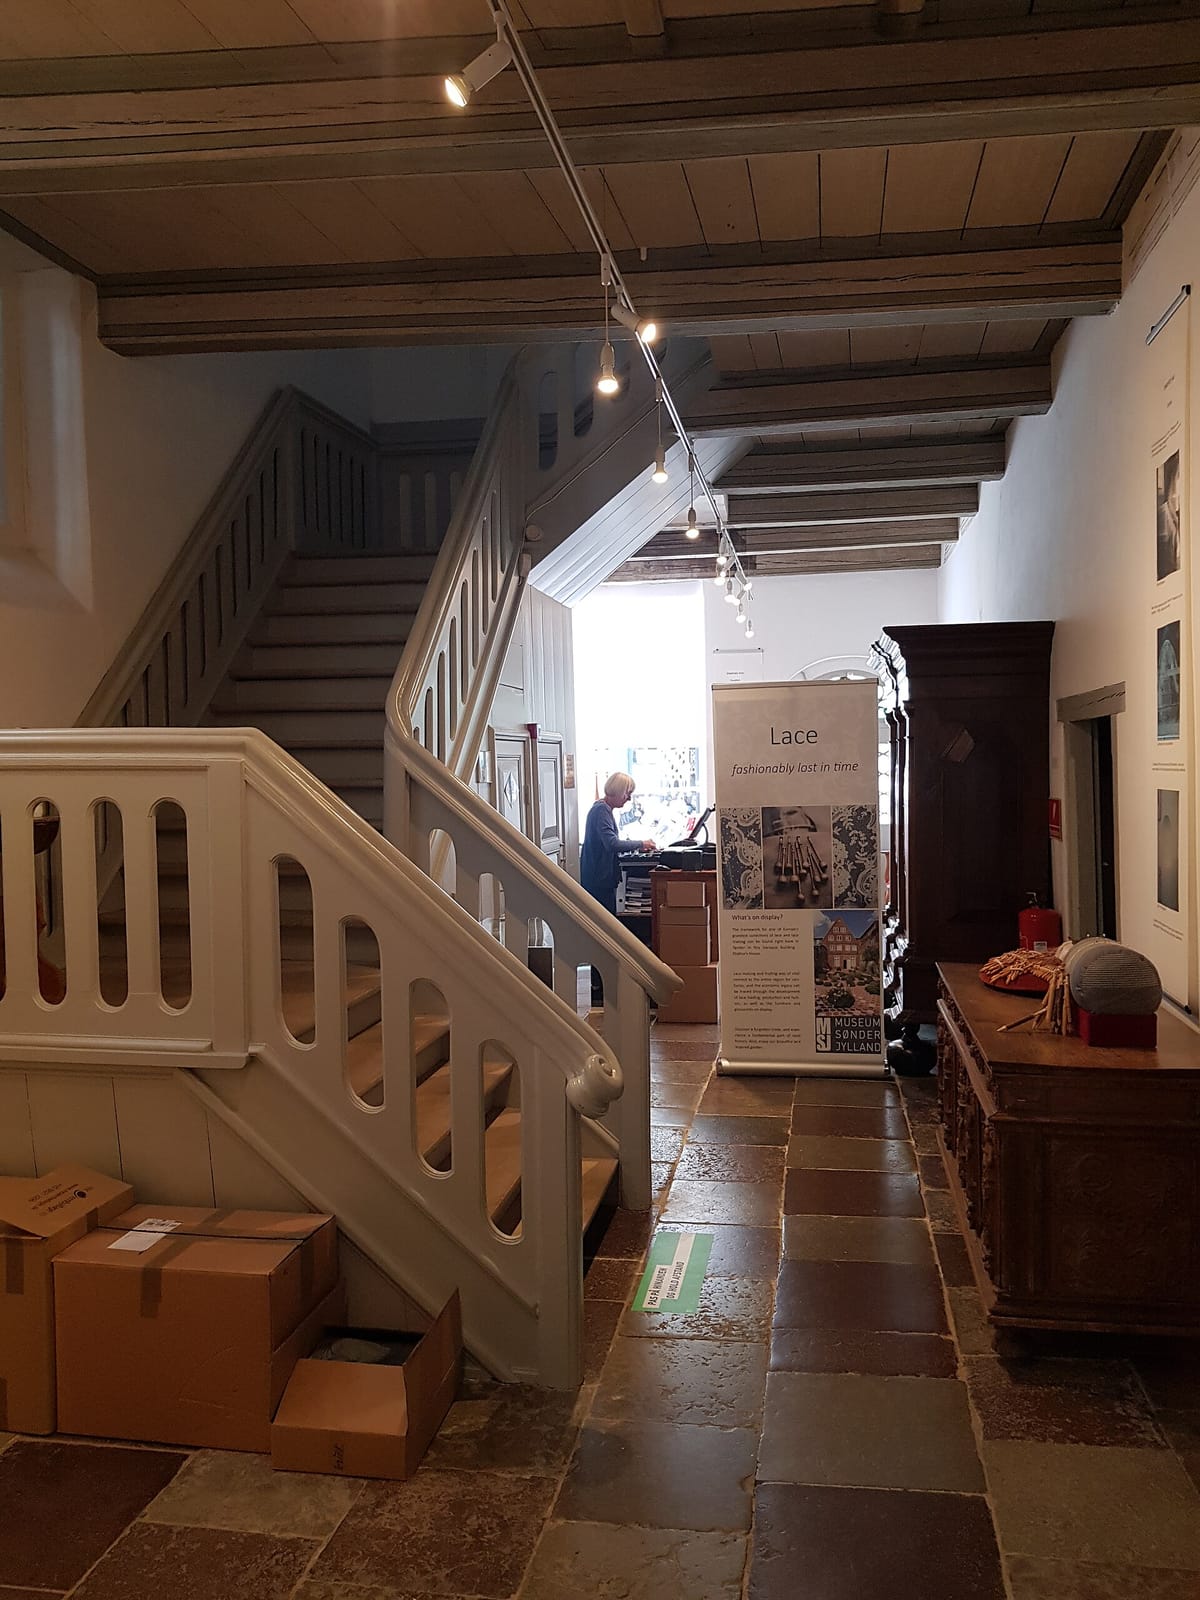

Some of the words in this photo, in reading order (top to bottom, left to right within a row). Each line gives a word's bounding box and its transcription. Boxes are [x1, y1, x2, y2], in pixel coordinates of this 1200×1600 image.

[770, 727, 818, 745] Lace
[731, 762, 795, 777] fashionably
[798, 762, 817, 773] lost
[820, 762, 830, 772] in
[833, 761, 859, 772] time
[816, 1017, 831, 1034] M
[834, 1017, 881, 1027] MUSEUM
[835, 1029, 881, 1040] SØNDER
[835, 1042, 881, 1052] JYLLAND
[647, 1296, 658, 1306] PAS
